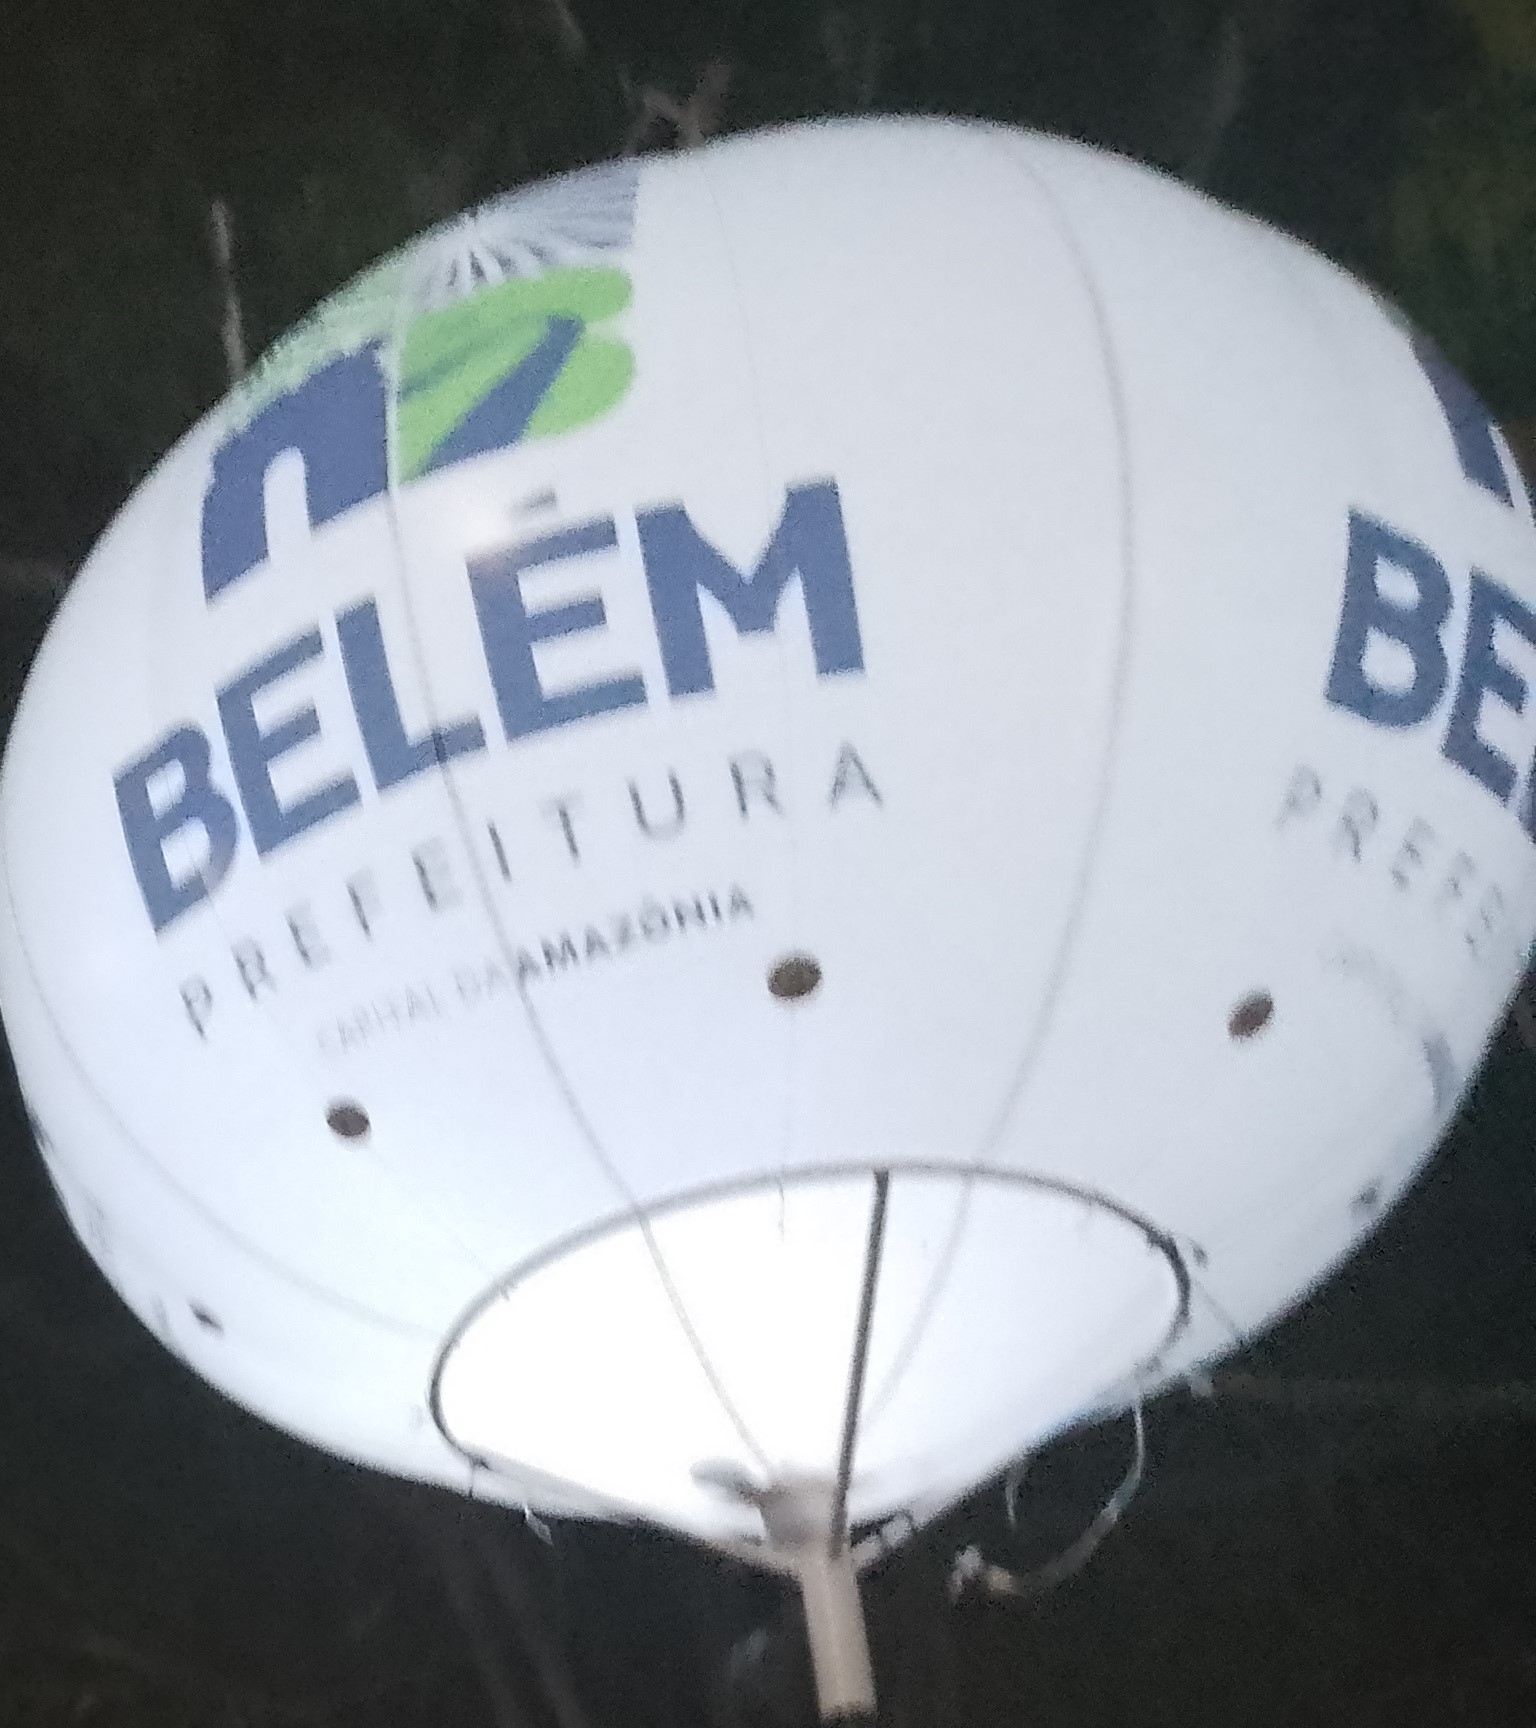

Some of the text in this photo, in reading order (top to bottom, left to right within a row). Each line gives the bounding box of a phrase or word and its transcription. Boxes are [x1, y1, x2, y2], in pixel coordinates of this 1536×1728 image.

[114, 474, 865, 936] BELÉM
[1324, 504, 1536, 845] BE
[178, 739, 885, 1043] PREFEITURA
